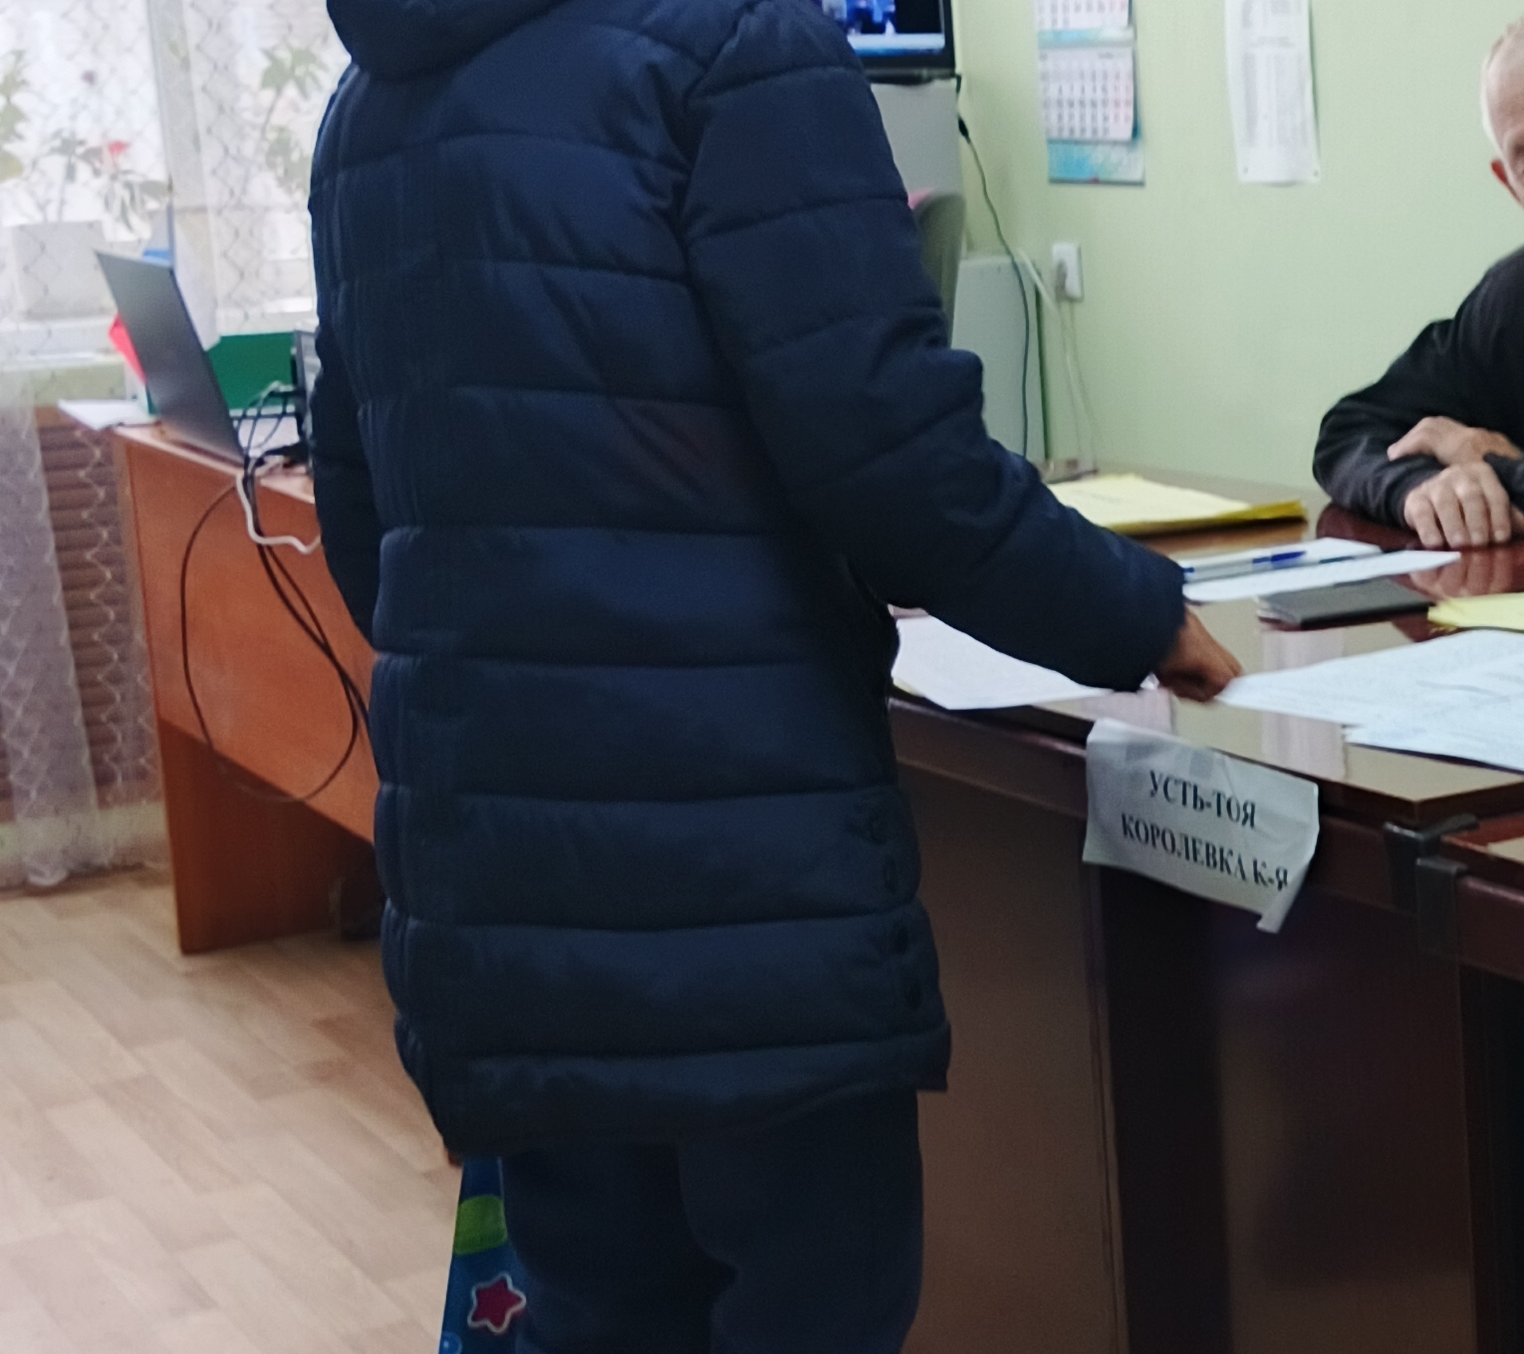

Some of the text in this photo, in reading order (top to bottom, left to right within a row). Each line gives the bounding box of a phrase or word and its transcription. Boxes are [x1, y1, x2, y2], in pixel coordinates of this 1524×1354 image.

[1150, 770, 1256, 829] УСТЬ-ТОЯ
[1121, 813, 1288, 892] КОРОЛЕВКА К-Я
